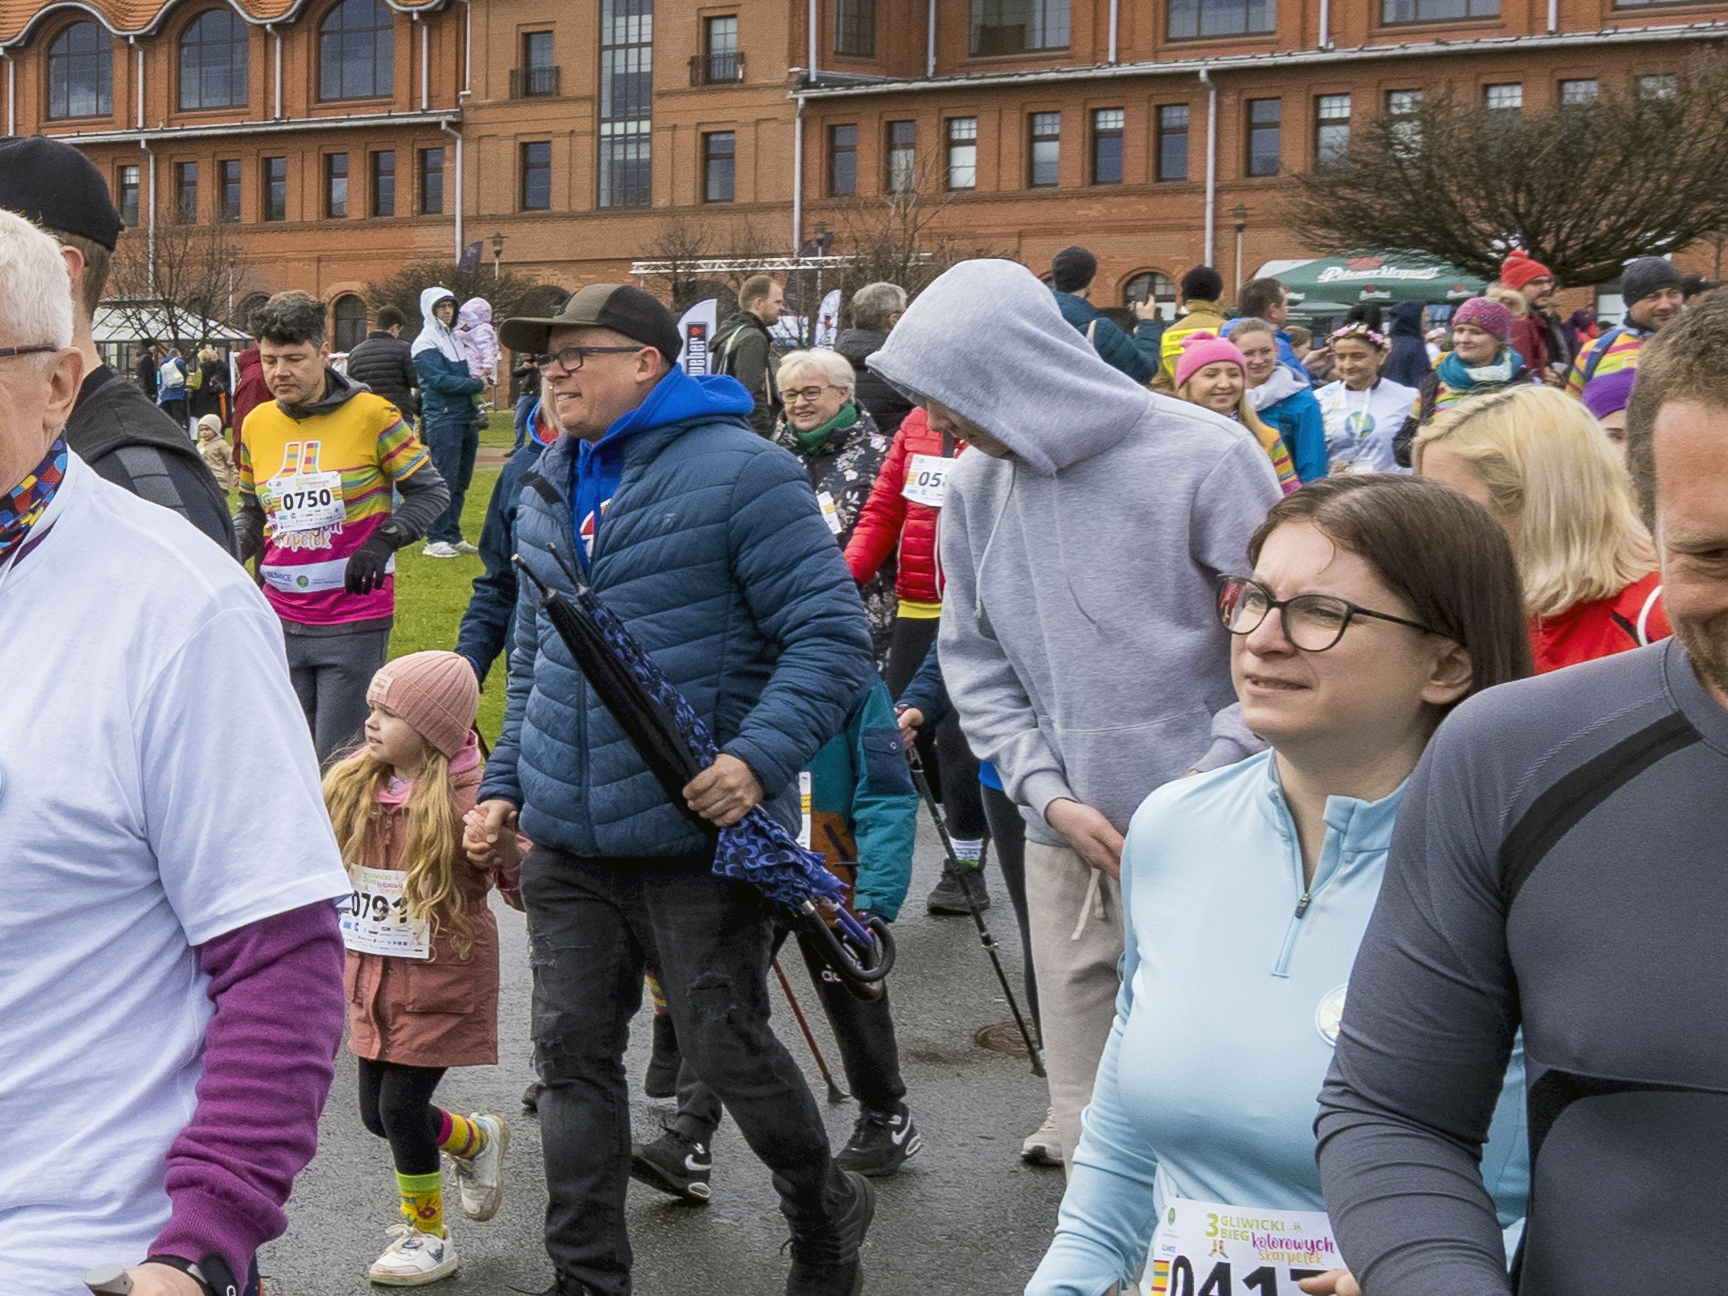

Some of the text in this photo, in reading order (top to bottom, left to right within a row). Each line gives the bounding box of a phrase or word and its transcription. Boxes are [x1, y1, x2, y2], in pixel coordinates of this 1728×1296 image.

[919, 471, 945, 488] 05
[283, 489, 331, 511] 0750
[1205, 1213, 1285, 1238] 3 GLIWICKI
[1220, 1228, 1334, 1254] BIEG kolorowych
[1258, 1249, 1323, 1266] skarpetek
